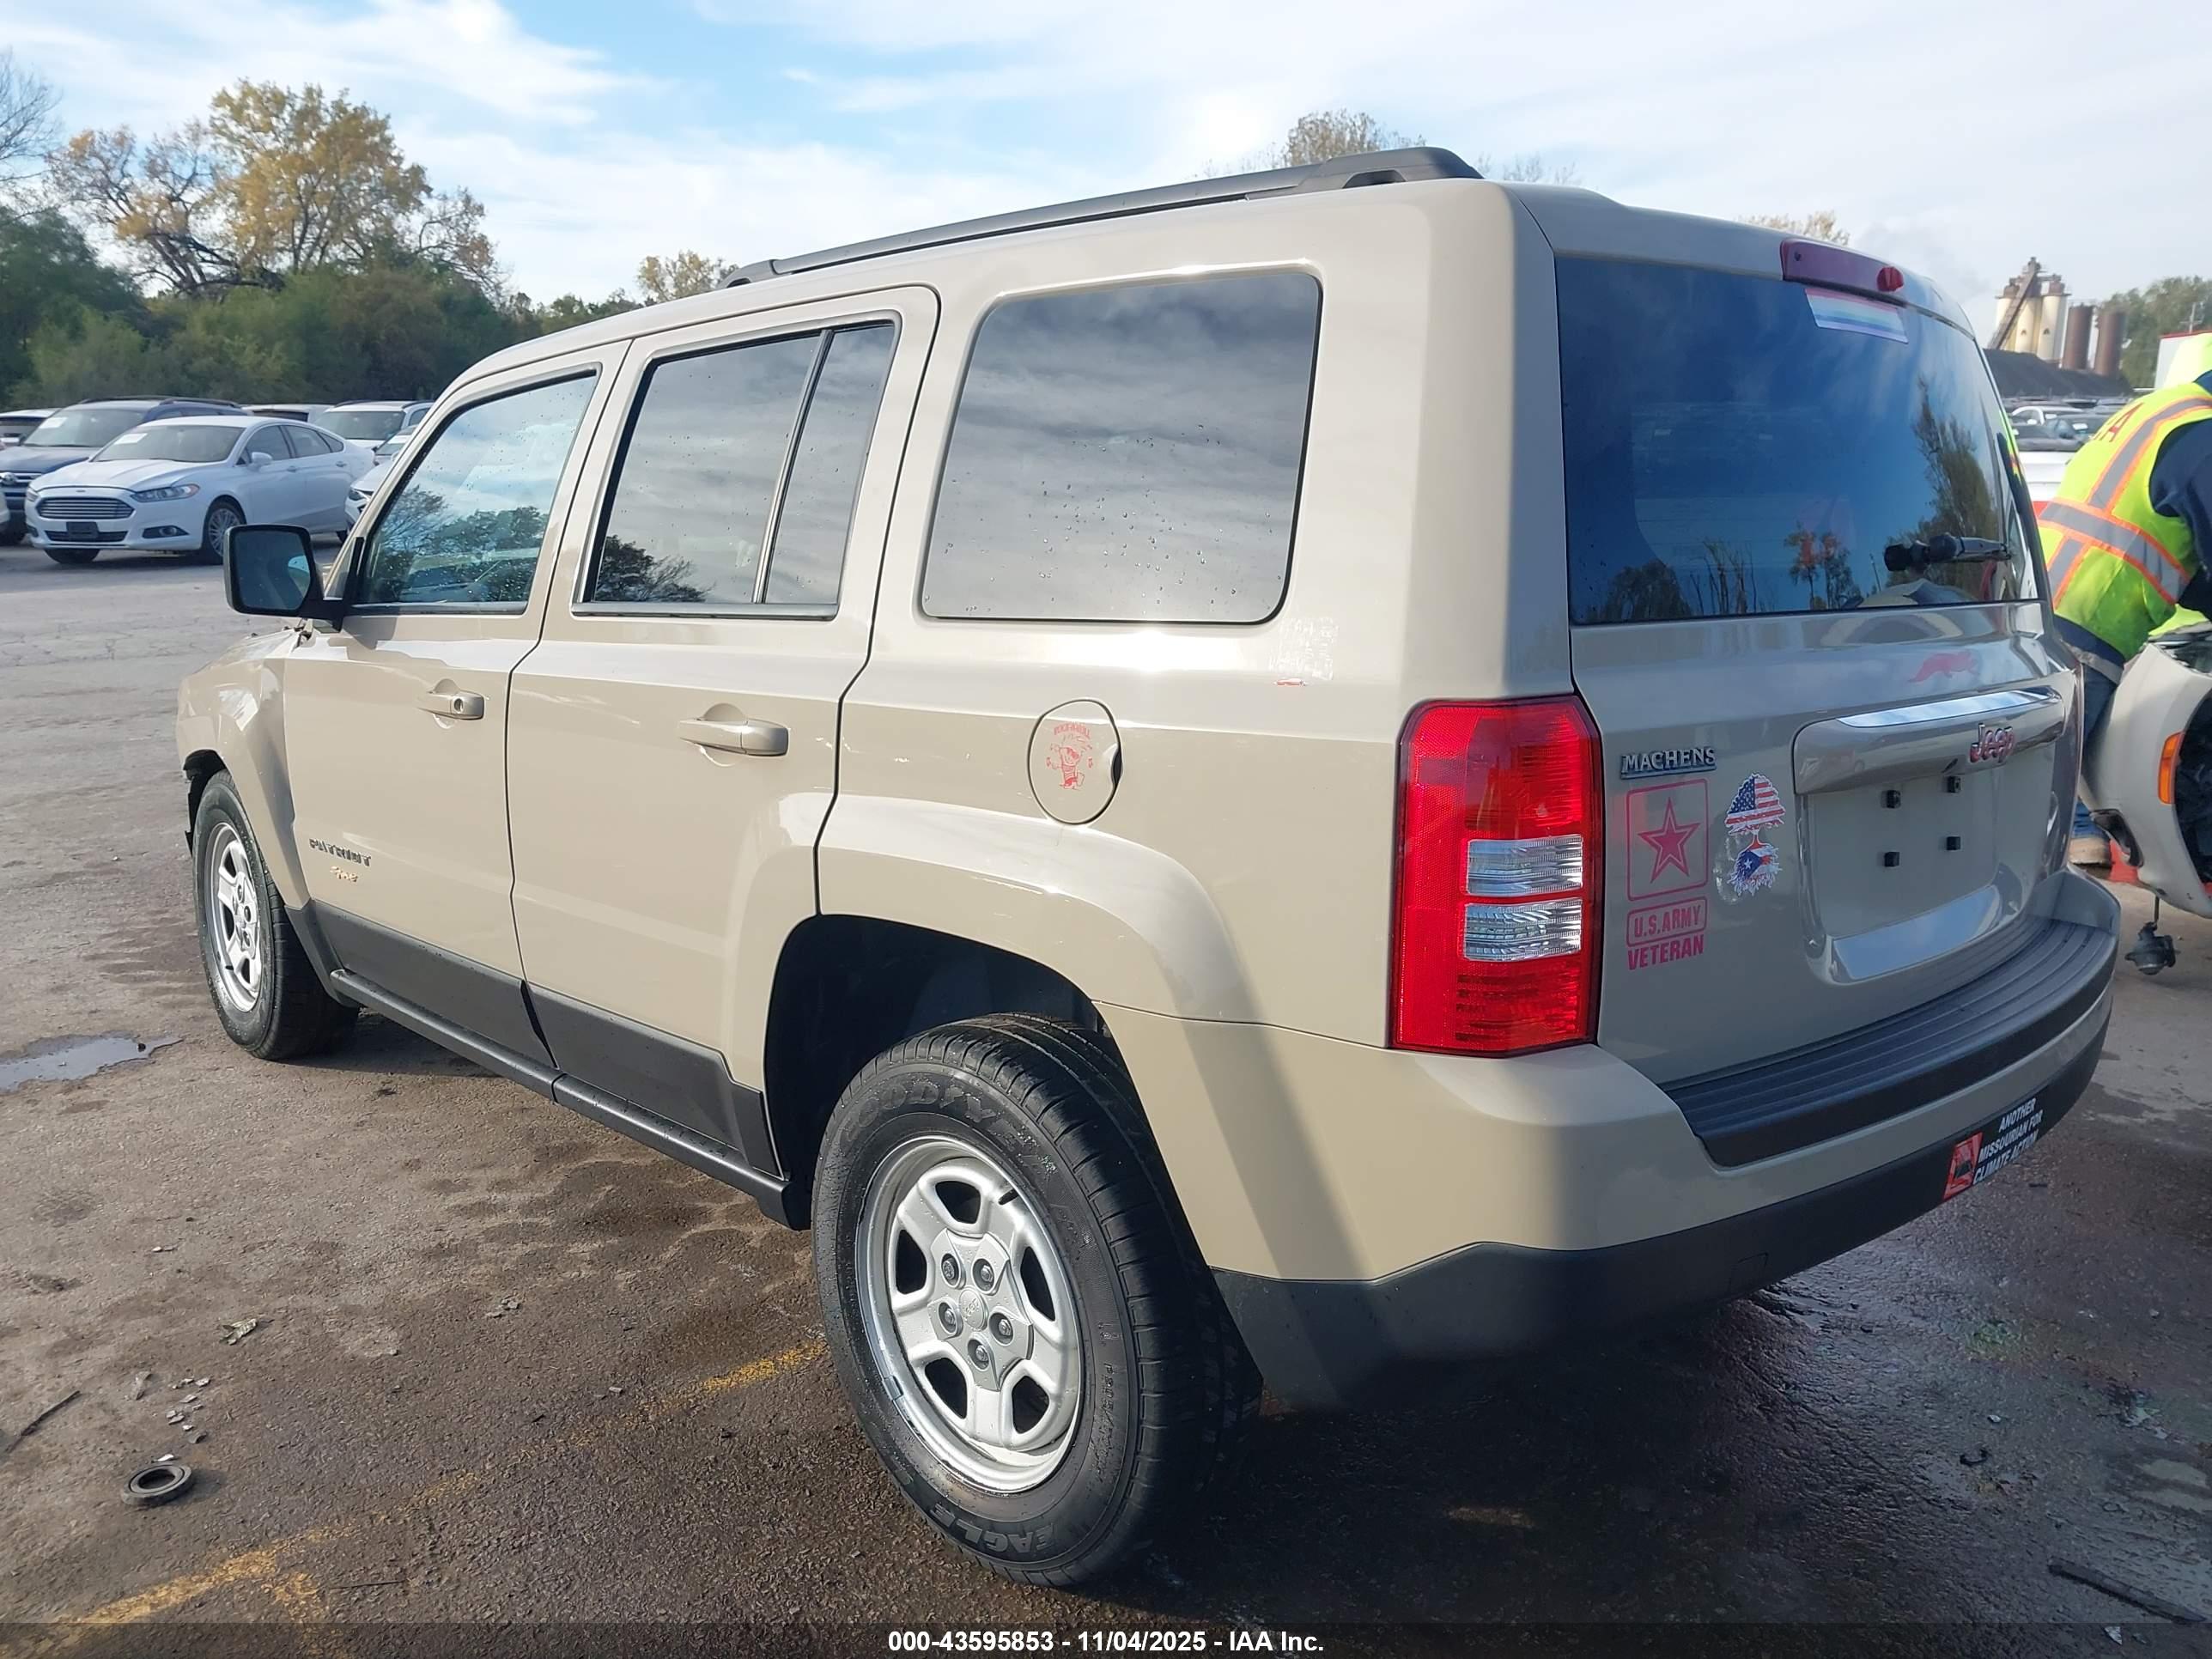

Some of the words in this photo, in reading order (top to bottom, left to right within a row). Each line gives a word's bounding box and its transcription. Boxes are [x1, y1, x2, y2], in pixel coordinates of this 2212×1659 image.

[1621, 748, 1717, 773] MACHENS
[1970, 723, 2014, 763] Jeep
[309, 838, 371, 866] PATRIOT
[1627, 934, 1704, 971] VETERAN
[1998, 1097, 2037, 1133] ANOTHER
[1978, 1121, 2028, 1164] MISSOURIAN
[2027, 1109, 2044, 1131] FOR
[1973, 1150, 2011, 1185] CLIMATE
[929, 1502, 1055, 1554] EAGLE
